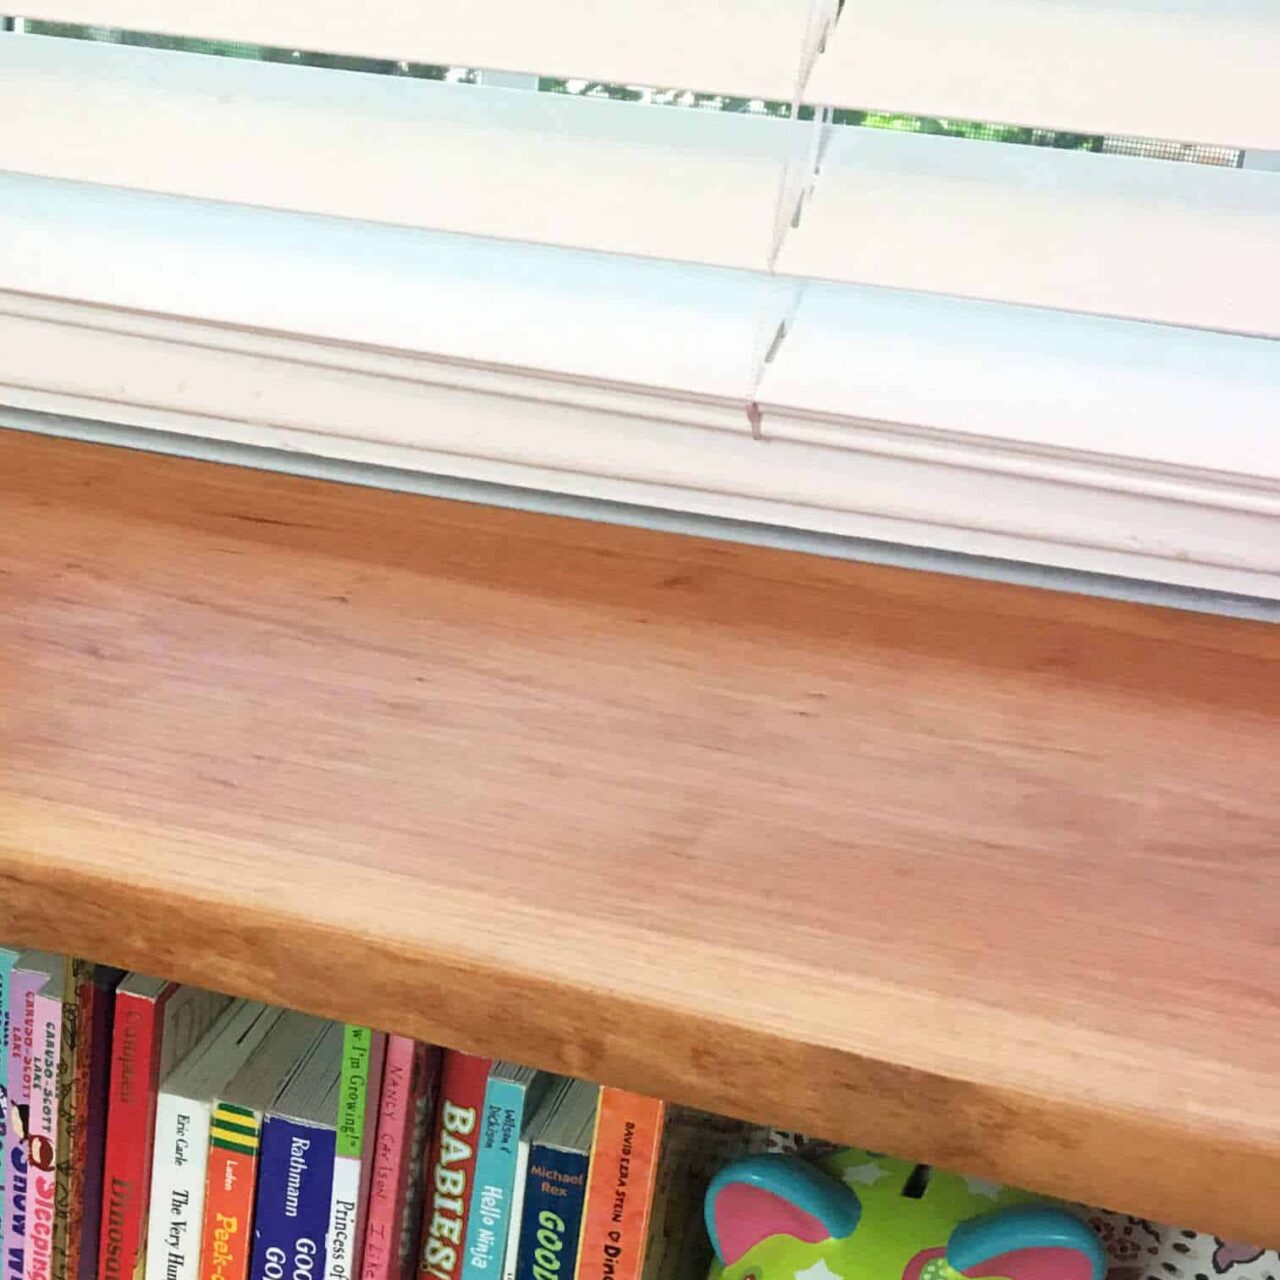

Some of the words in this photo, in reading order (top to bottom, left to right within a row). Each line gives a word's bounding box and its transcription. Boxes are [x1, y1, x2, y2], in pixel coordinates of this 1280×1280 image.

[41, 1021, 57, 1133] CARUSO-SCOTT
[176, 1113, 191, 1138] Eric
[174, 1139, 191, 1167] Carle
[285, 1136, 310, 1217] Rathmann
[529, 1164, 584, 1186] Michael
[541, 1181, 569, 1198] Rex
[170, 1190, 189, 1216] The
[479, 1184, 503, 1226] Hello
[164, 1217, 187, 1249] Very
[331, 1200, 355, 1259] Princess
[469, 1227, 496, 1269] Ninja
